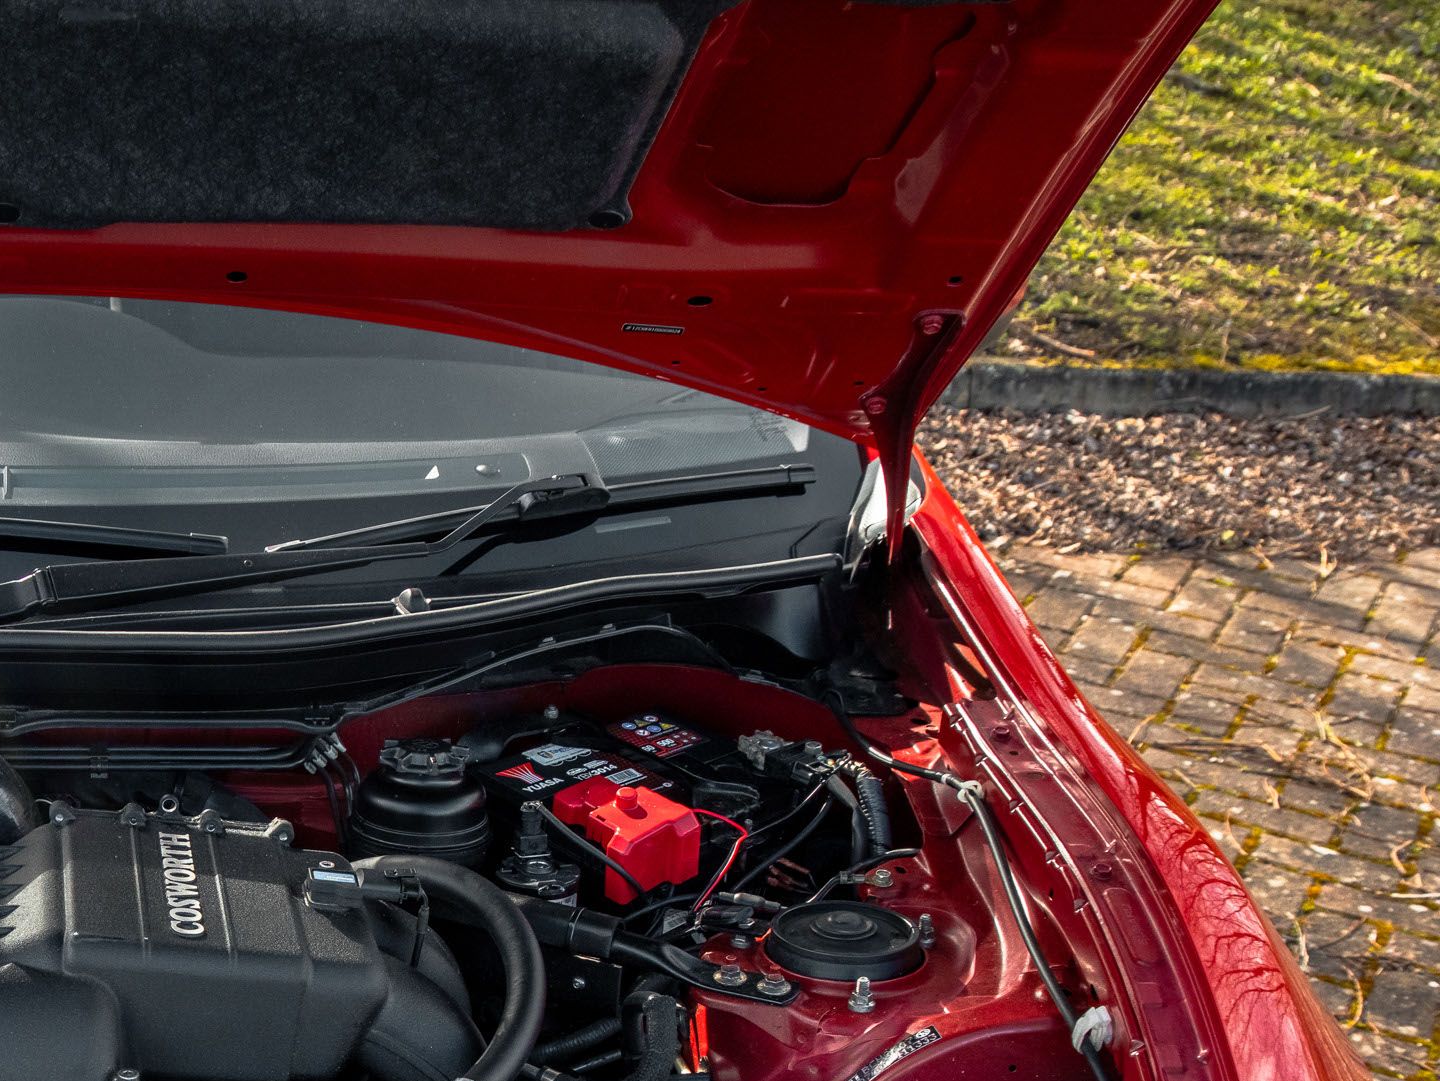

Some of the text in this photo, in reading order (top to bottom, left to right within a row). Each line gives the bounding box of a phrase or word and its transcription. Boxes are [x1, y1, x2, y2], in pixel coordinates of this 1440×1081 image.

[573, 764, 618, 780] YBX3014
[522, 777, 564, 793] YUASA
[158, 832, 206, 938] COSWORTH
